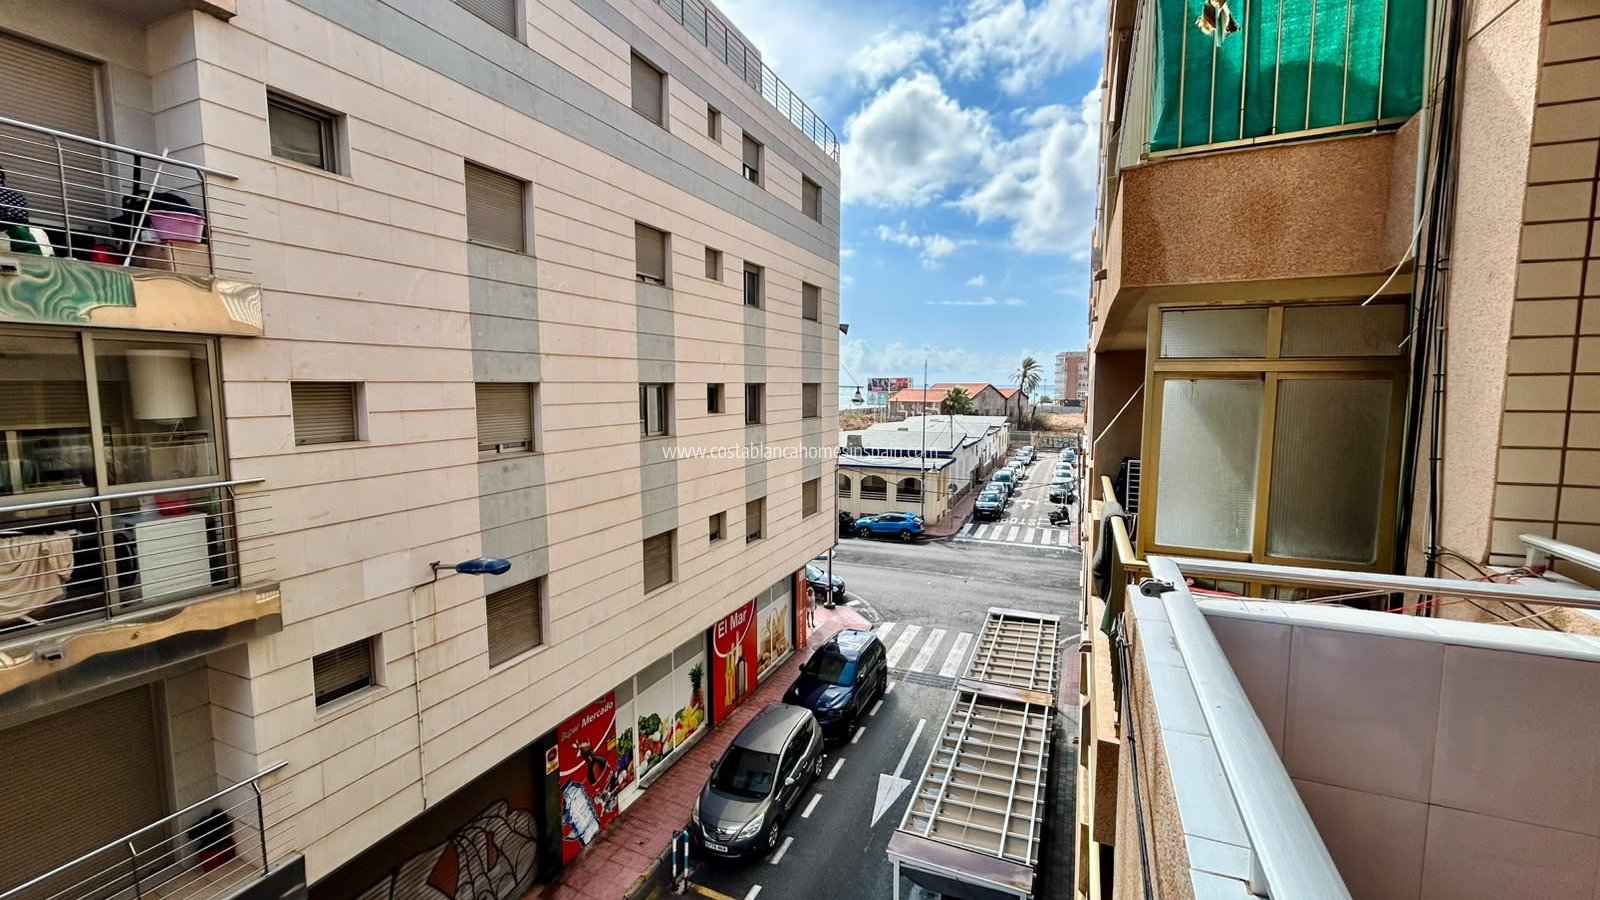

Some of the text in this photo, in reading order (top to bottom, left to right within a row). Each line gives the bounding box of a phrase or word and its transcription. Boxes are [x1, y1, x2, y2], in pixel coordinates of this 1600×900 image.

[717, 610, 747, 639] El Mar
[581, 701, 613, 728] Mercado
